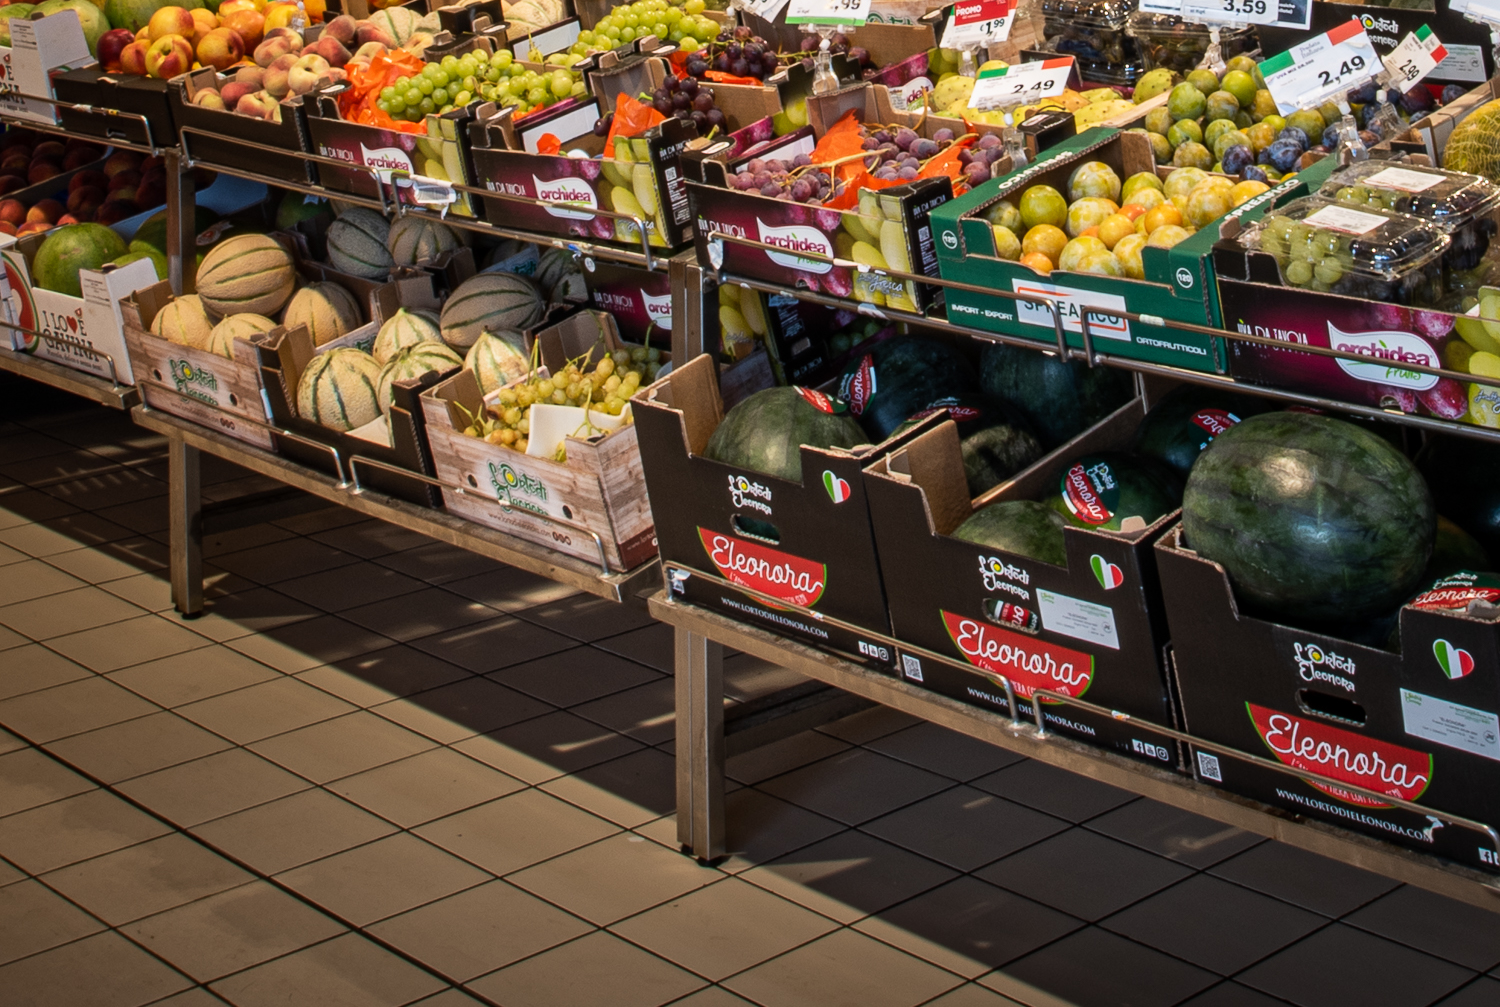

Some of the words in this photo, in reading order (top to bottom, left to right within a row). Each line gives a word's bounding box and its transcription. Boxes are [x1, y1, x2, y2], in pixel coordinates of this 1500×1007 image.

[956, 5, 982, 17] PROMO
[1317, 54, 1365, 88] 2,49
[365, 152, 410, 172] orchidea
[540, 186, 592, 204] orchidea
[764, 233, 827, 254] orchidea
[951, 304, 979, 316] IMPORT
[984, 309, 1013, 321] EXPORT
[1135, 335, 1208, 357] ORTOFRUTTICOLI
[1336, 335, 1431, 369] orchidea
[1068, 463, 1104, 521] Eleonora
[711, 534, 824, 593] Eleonora
[956, 620, 1091, 686] Eleonora
[1299, 661, 1356, 693] Eleonora
[1265, 713, 1428, 789] Eleonora
